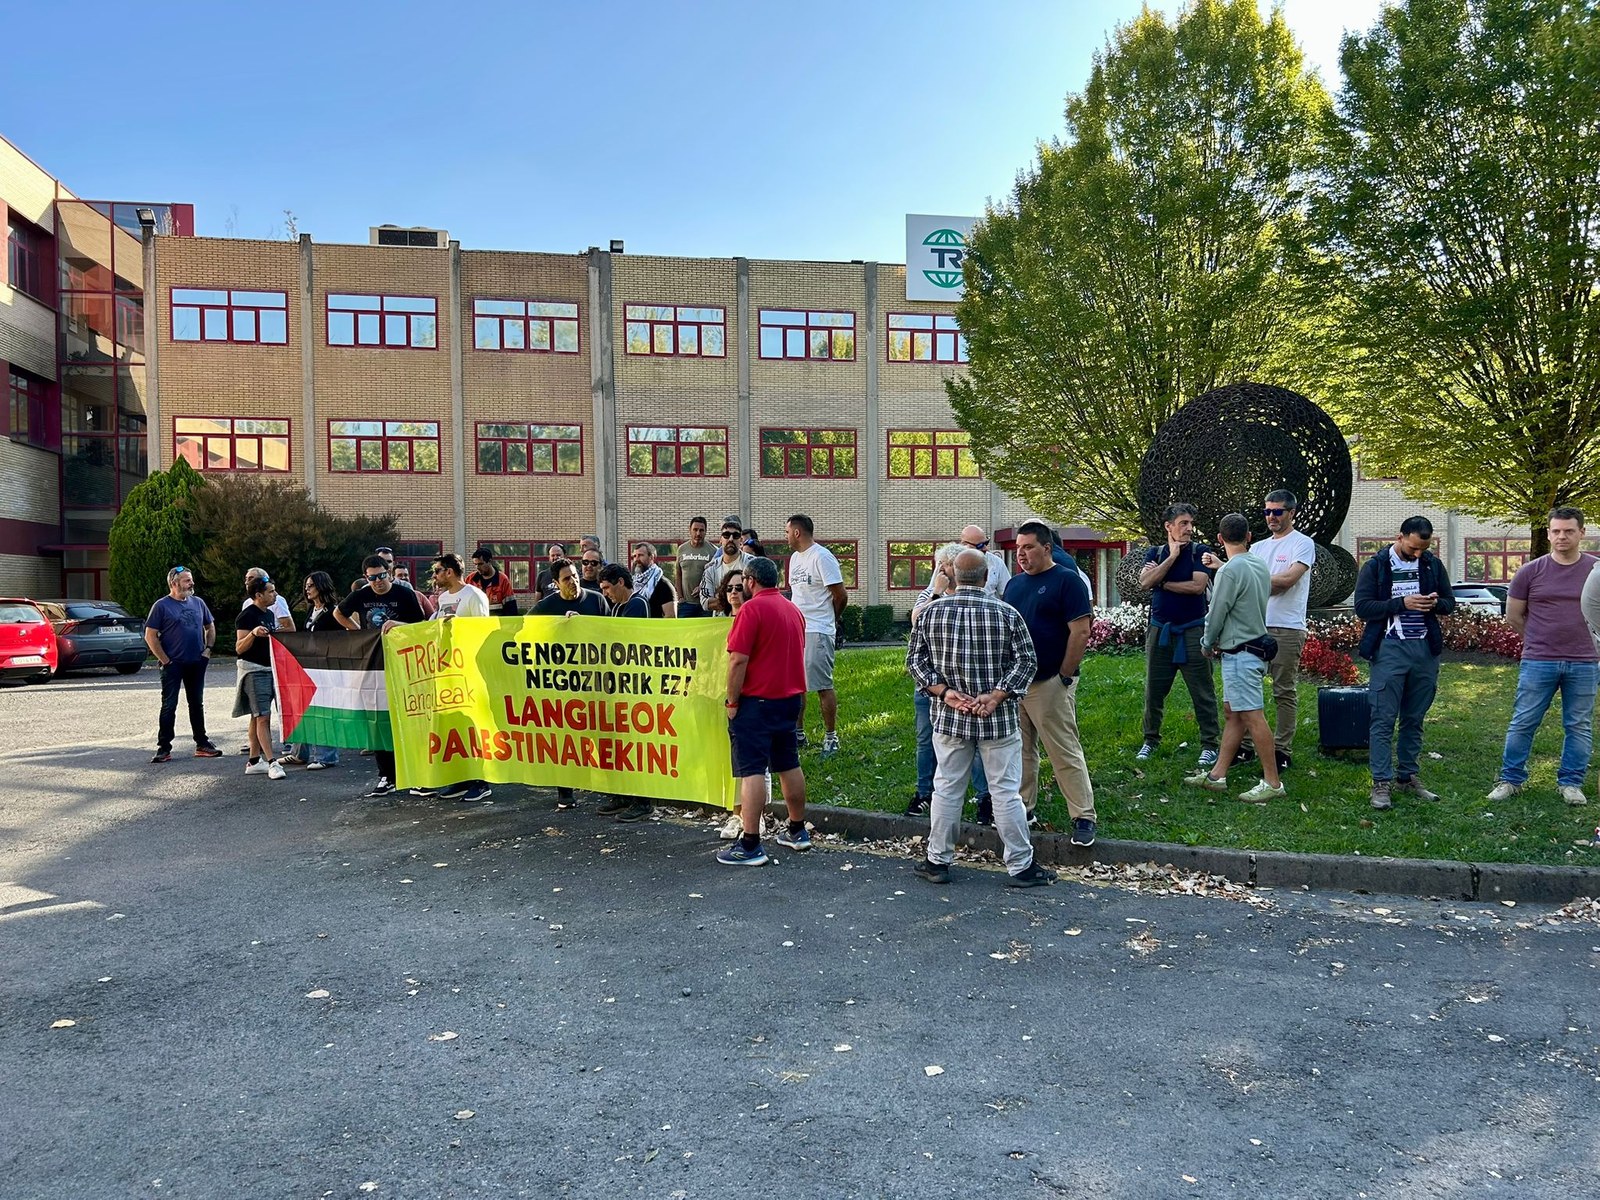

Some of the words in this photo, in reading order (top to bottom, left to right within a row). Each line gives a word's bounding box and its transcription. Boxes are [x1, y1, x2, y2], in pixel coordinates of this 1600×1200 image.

[930, 248, 963, 269] TR
[501, 641, 697, 670] GENOZIDIOAREKIN
[526, 668, 653, 695] NEGOZIORIK
[660, 674, 692, 697] EZ!
[504, 695, 678, 737] LANGILEOK
[429, 726, 679, 778] PALESTINAREKIN!
